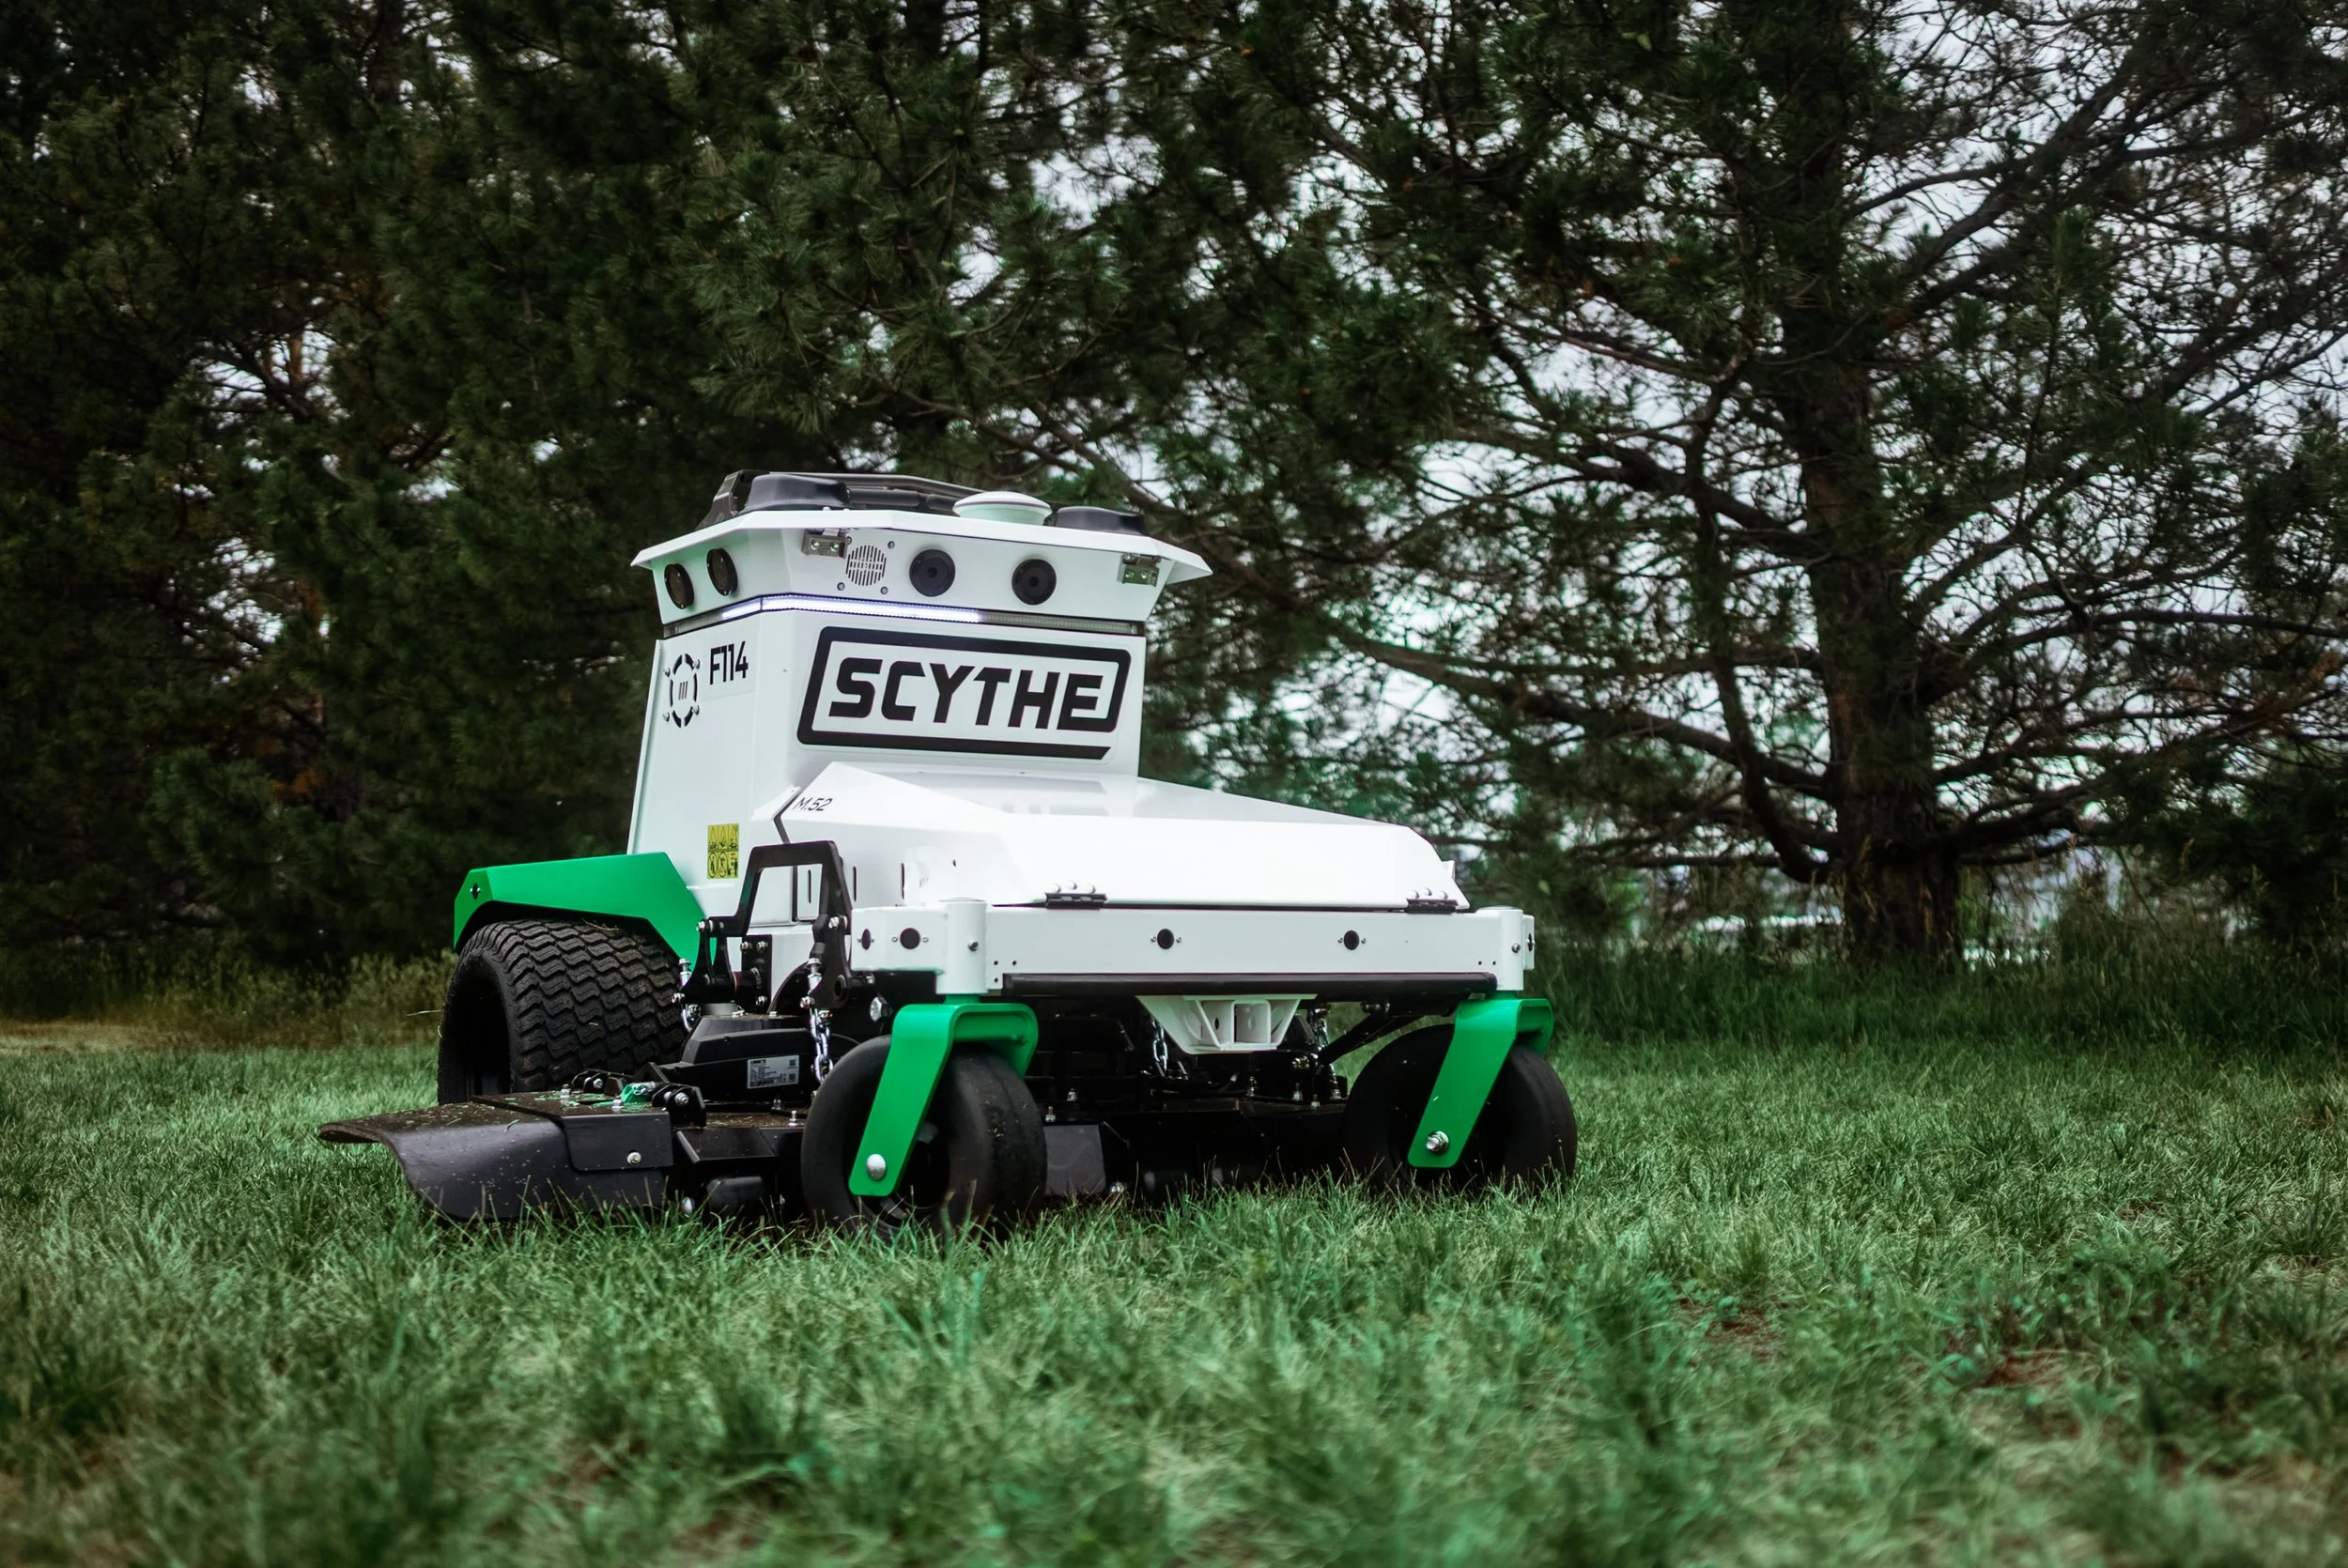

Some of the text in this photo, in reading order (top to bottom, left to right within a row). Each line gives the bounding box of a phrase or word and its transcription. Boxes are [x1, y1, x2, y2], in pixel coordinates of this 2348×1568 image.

[709, 640, 749, 685] F114
[828, 656, 1116, 733] SCYTHE
[792, 797, 833, 811] M.52
